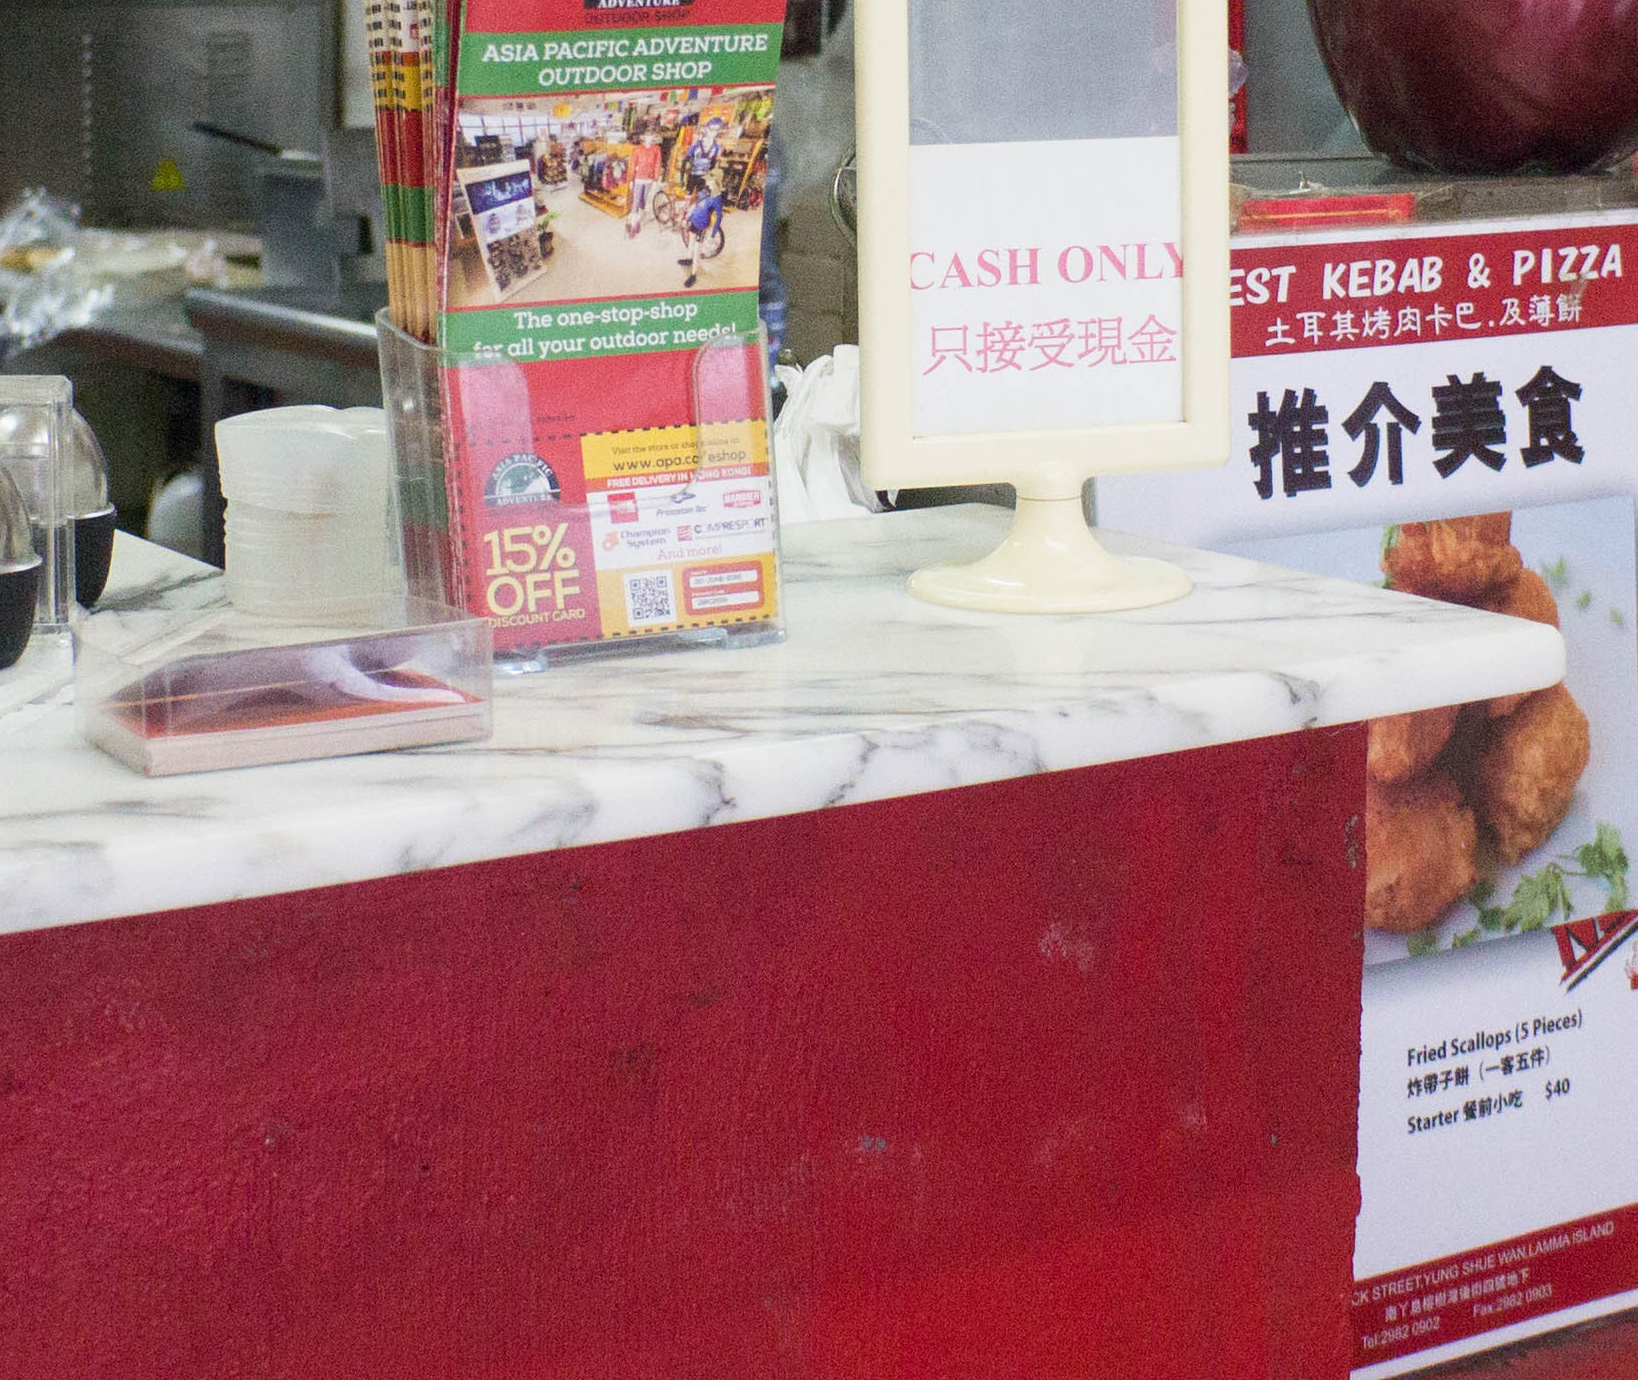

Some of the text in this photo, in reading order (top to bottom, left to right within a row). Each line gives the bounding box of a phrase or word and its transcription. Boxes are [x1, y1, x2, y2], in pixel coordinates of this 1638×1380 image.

[482, 34, 769, 63] ASIA PACIFIC ADVENTURE
[538, 61, 713, 88] OUTDOOR SHOP
[908, 240, 1185, 291] CASH ONLY
[1321, 255, 1444, 301] KEBAB
[1466, 252, 1492, 290] &
[1512, 243, 1624, 287] PIZZA
[514, 301, 699, 330] The one-stop-shop
[473, 321, 737, 361] for all your outdoor needs!
[922, 312, 1178, 377] 只接受現金
[1247, 365, 1586, 501] 推介美食
[606, 478, 632, 489] FREE
[632, 474, 677, 487] DELIVERY
[677, 472, 688, 481] IN
[483, 522, 576, 576] 15%
[657, 543, 722, 560] And more!
[486, 569, 581, 617] OFF
[488, 607, 586, 629] DISCOUNT CARD
[1406, 1007, 1583, 1068] Fried Scallops (5 Pieces)
[1407, 1077, 1571, 1135] Starter 餐前小吃 $40
[1461, 1253, 1495, 1276] SHUE
[1411, 1315, 1441, 1337] 0902
